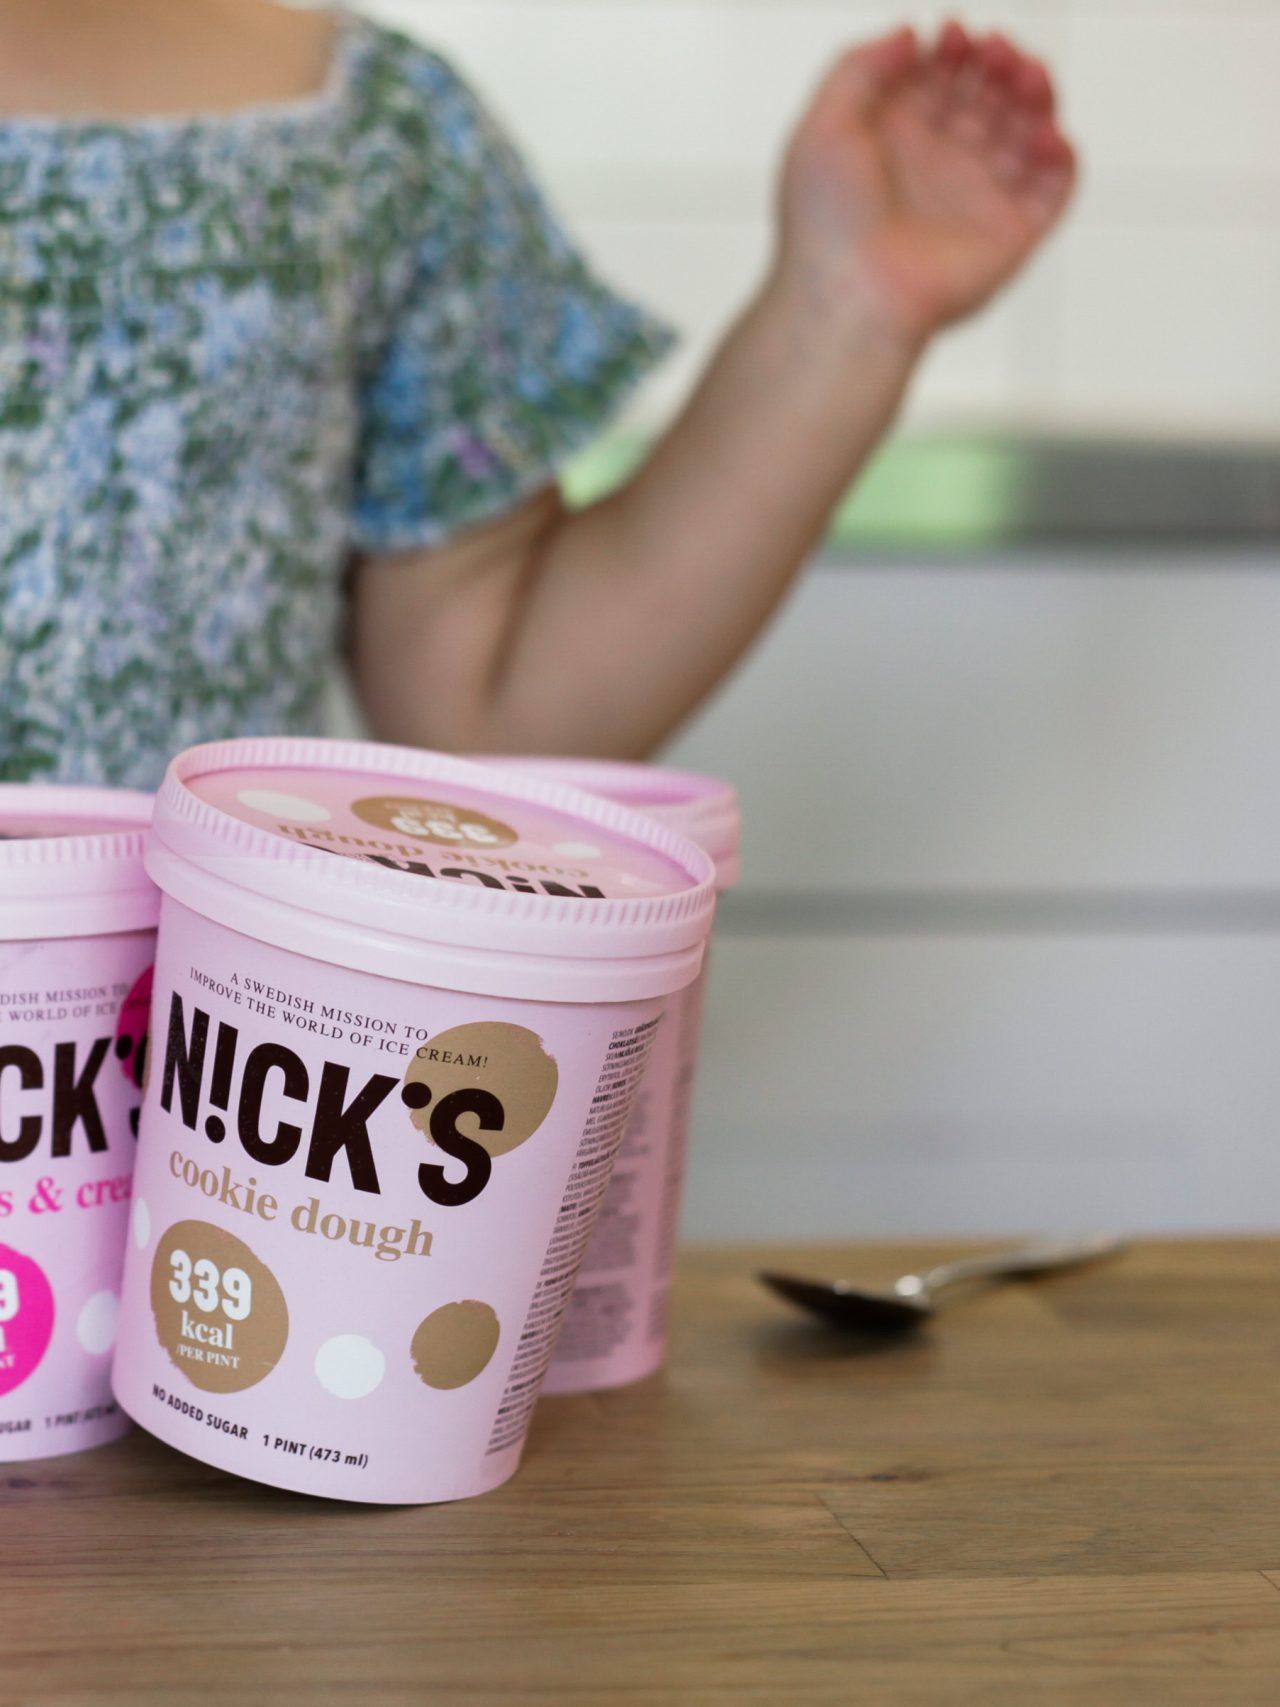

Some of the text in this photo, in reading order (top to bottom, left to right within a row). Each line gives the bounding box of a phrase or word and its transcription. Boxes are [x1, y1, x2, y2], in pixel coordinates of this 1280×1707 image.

[10, 1007, 67, 1021] WORLD
[73, 1004, 90, 1018] OF
[45, 986, 106, 1004] MISSION
[230, 972, 428, 1041] A SWEDISH MISSION TO
[190, 966, 488, 1068] IMPROVE THE WORLD OF ICE CREAM!
[28, 1176, 62, 1214] &
[169, 1150, 434, 1262] cookie dough
[168, 1248, 253, 1321] 339
[180, 1310, 233, 1350] kcal
[207, 1349, 240, 1369] PINT
[152, 1384, 248, 1440] NO ADDED SUGAR
[263, 1434, 369, 1469] 1 PINT (473 ml)
